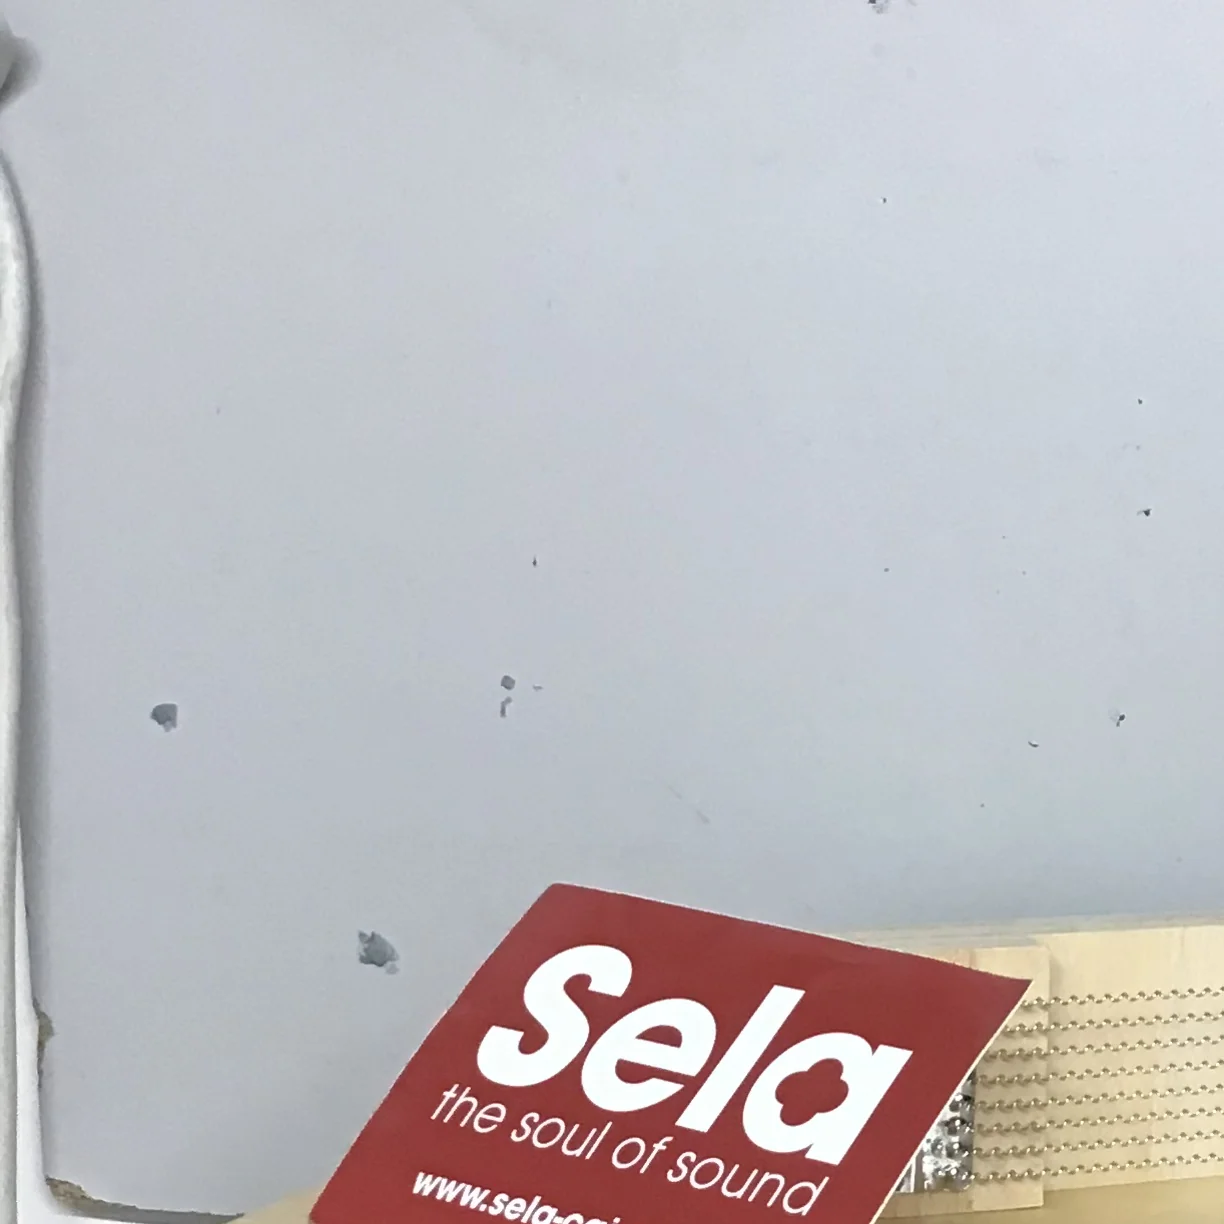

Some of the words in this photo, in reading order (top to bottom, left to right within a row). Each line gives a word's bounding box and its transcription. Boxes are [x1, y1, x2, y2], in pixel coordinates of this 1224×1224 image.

[476, 944, 913, 1166] Sela
[430, 1083, 507, 1134] the
[511, 1112, 612, 1160] soul
[612, 1136, 674, 1174] of
[667, 1152, 830, 1217] sound
